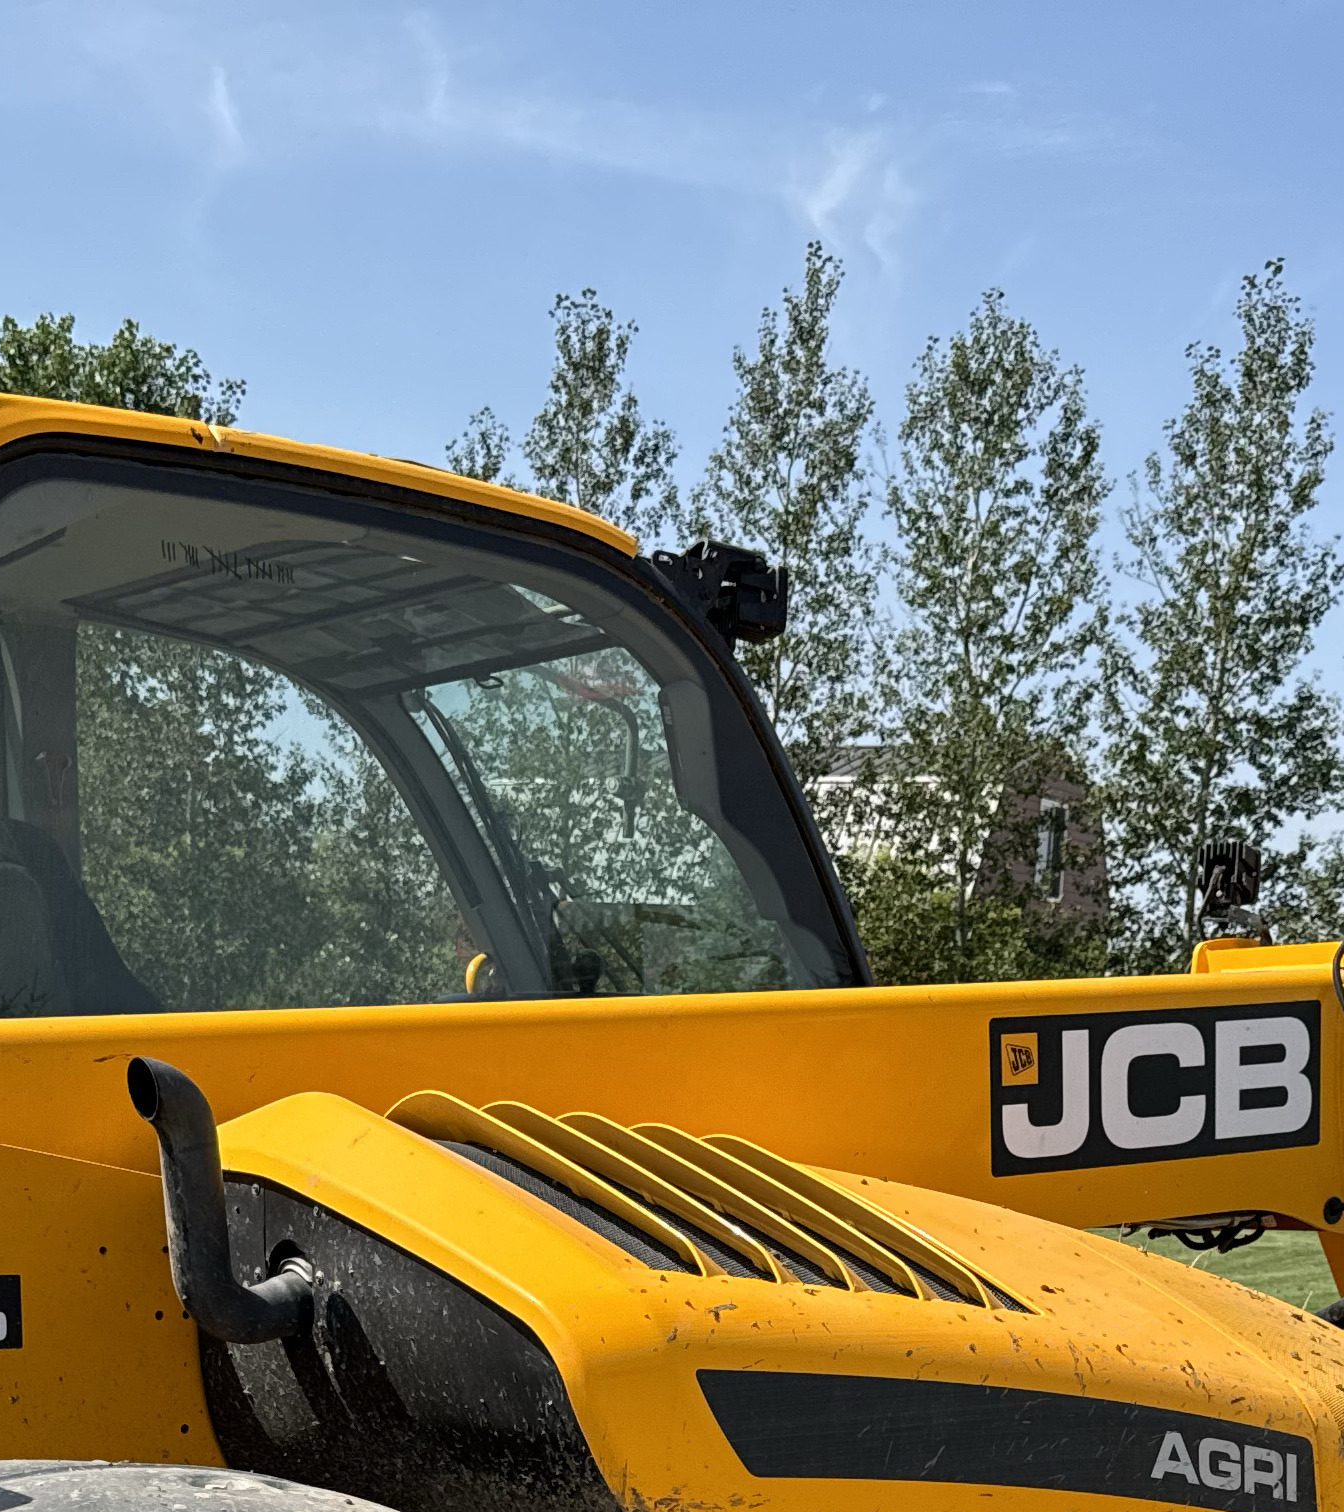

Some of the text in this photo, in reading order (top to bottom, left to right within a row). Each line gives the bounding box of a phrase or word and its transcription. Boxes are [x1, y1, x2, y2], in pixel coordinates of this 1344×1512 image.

[1002, 1016, 1312, 1159] JCB
[1011, 1047, 1033, 1072] JCB
[1150, 1430, 1298, 1503] AGRI
